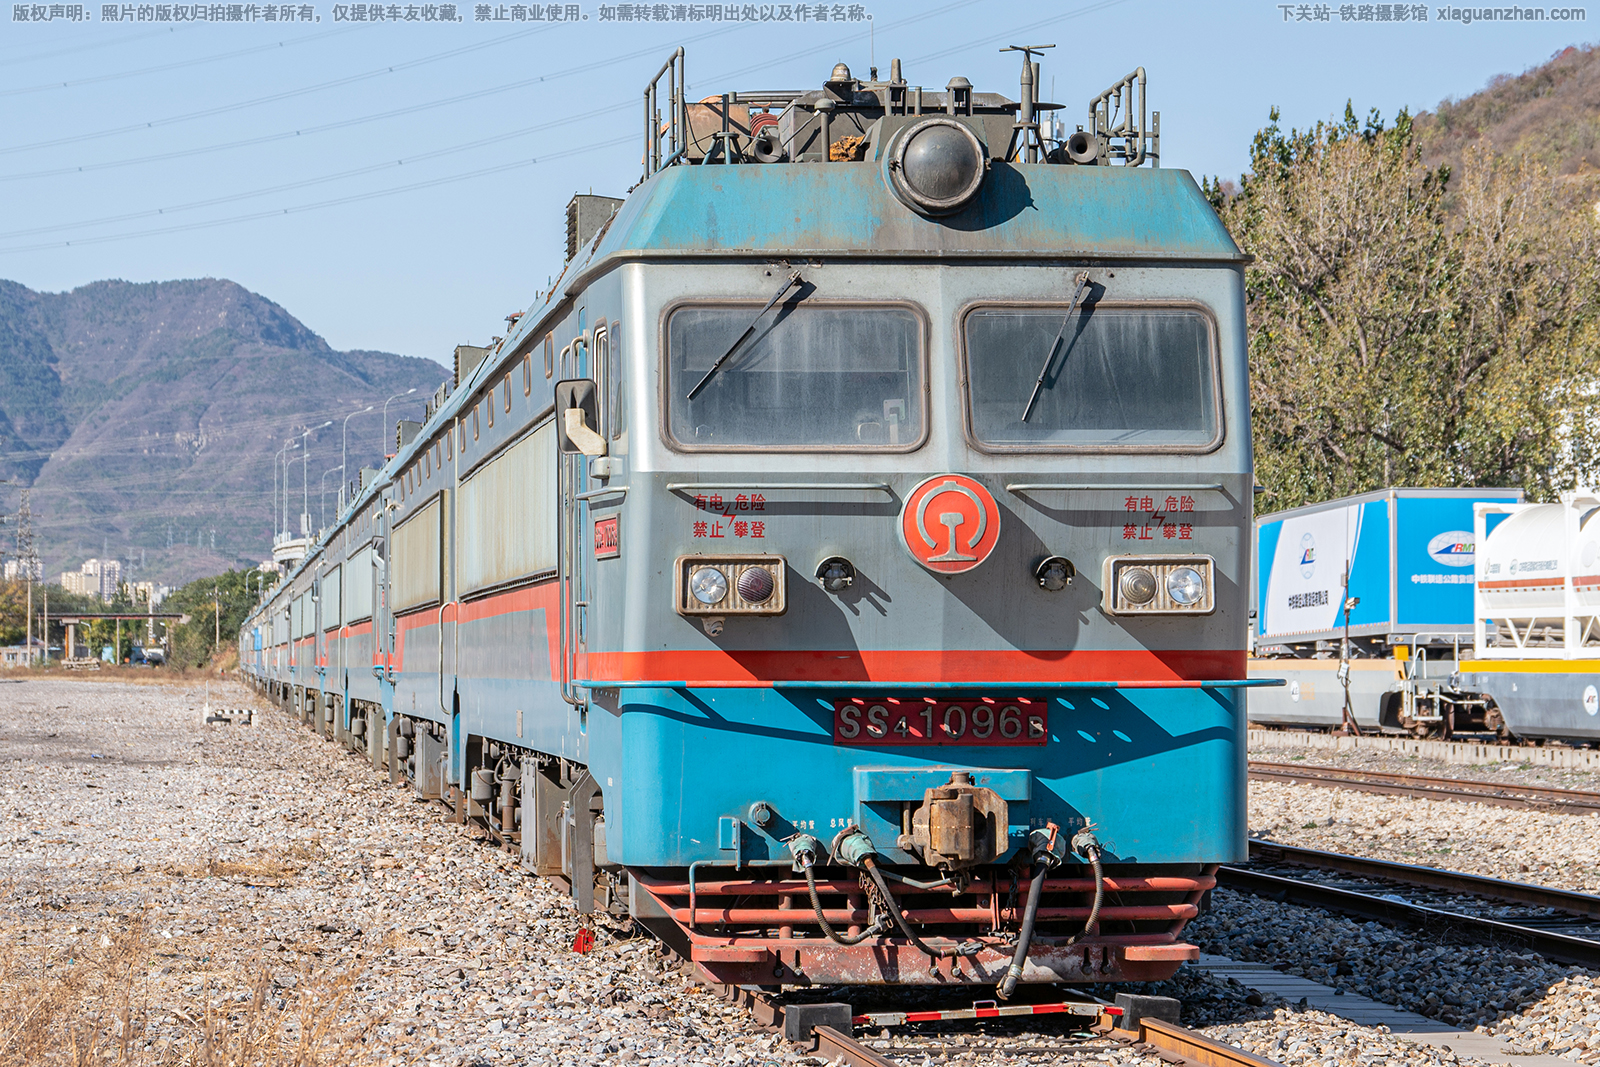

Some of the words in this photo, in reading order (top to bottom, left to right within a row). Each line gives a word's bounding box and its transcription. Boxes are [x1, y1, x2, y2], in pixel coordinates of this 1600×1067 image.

[693, 493, 725, 511] 有电
[734, 493, 766, 511] 危险
[1124, 495, 1154, 512] 有电
[1164, 495, 1195, 512] 危险
[693, 520, 725, 538] 禁止
[734, 520, 765, 538] 攀登
[1122, 522, 1153, 540] 禁止
[1163, 522, 1193, 540] 攀登
